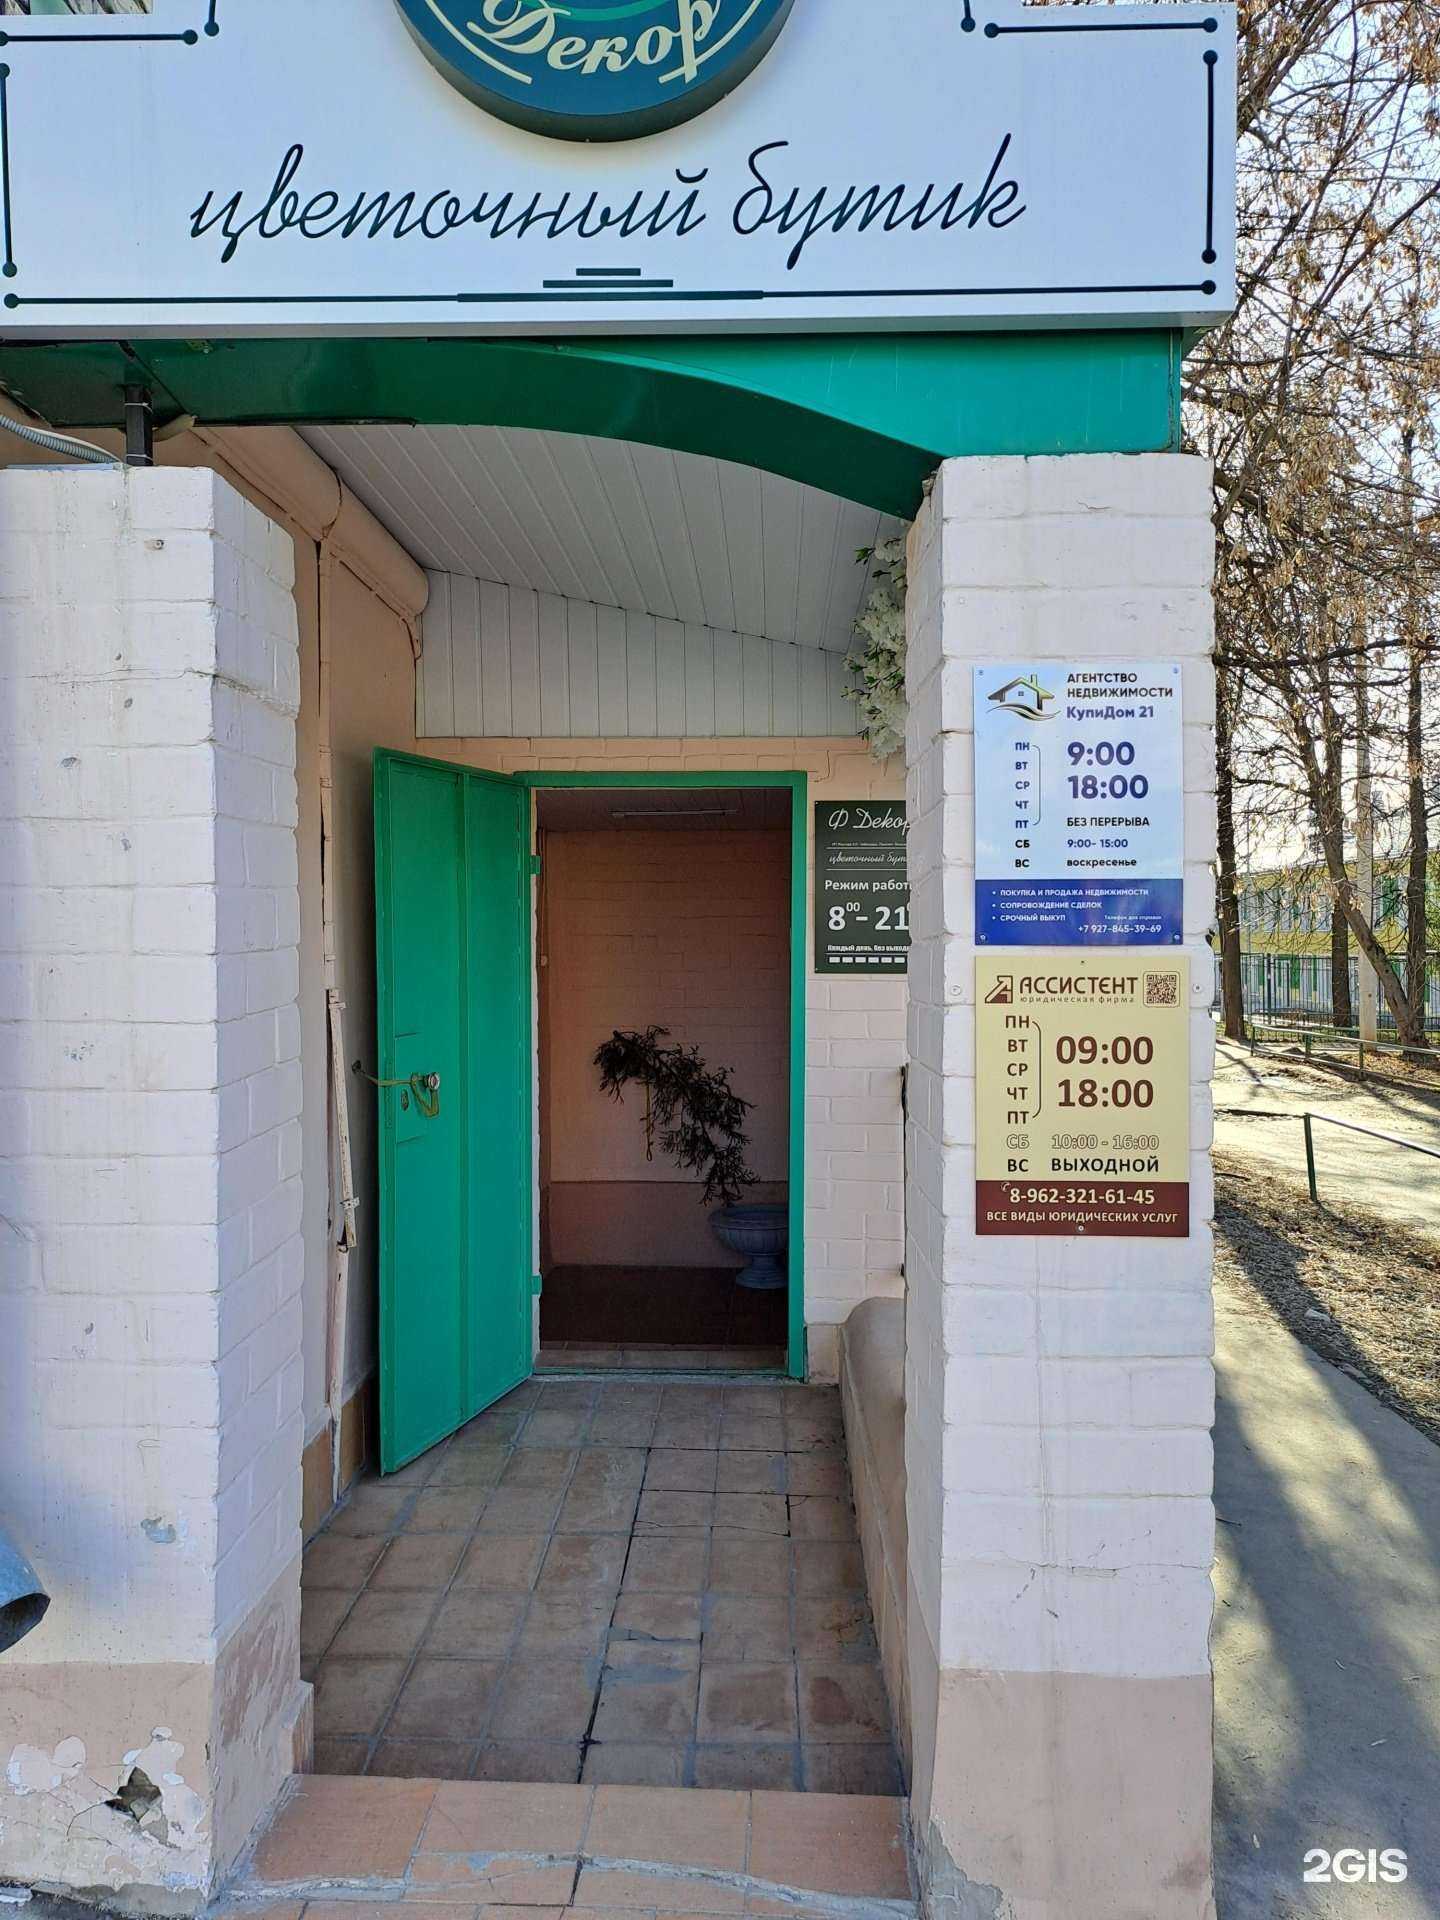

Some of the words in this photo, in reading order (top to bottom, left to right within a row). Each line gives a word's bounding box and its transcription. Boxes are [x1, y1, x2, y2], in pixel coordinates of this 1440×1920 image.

[466, 0, 722, 84] Декор
[189, 143, 709, 263] цветочный
[733, 133, 1026, 270] бутик
[1067, 673, 1138, 683] АГЕНТСТВО
[1067, 687, 1173, 699] НЕДВИЖИМОСТИ
[1066, 706, 1135, 721] КупиДом
[1139, 705, 1154, 718] 21
[1015, 742, 1030, 751] ПН
[1067, 741, 1136, 766] 9:00
[1015, 761, 1029, 770] ВТ
[1015, 781, 1030, 790] СР
[1067, 775, 1149, 799] 18:00
[1015, 800, 1029, 810] ЧТ
[828, 808, 849, 830] Ф
[1015, 820, 1029, 829] ПТ
[1067, 817, 1087, 827] БЕЗ
[1090, 817, 1149, 827] ПЕРЕРЫВА
[1015, 840, 1030, 849] СБ
[1100, 839, 1129, 848] 15:00
[1015, 859, 1030, 868] ВС
[1067, 858, 1137, 868] воскресенье
[825, 880, 869, 890] Режим
[1045, 889, 1083, 897] ПРОДАЖА
[1000, 913, 1038, 921] СРОЧНЫЙ
[1078, 924, 1089, 933] +7
[1091, 924, 1162, 933] 927-845-39-69
[1019, 976, 1138, 994] АССИСТЕНТ
[1020, 996, 1094, 1004] юридическая
[1098, 996, 1134, 1004] фирма
[1005, 1015, 1030, 1029] ПН
[1008, 1039, 1028, 1053] ВТ
[1056, 1035, 1154, 1065] 09:00
[1007, 1063, 1028, 1077] СР
[1007, 1087, 1028, 1100] ЧТ
[1057, 1078, 1154, 1108] 18:00
[1007, 1111, 1029, 1125] ПТ
[1006, 1134, 1030, 1149] СБ
[1052, 1134, 1098, 1150] 10:00
[1112, 1134, 1159, 1150] 16:00
[1007, 1158, 1029, 1172] ВС
[1051, 1156, 1159, 1175] ВЫХОДНОЙ
[1009, 1188, 1155, 1204] 8-962-321-61-45
[987, 1211, 1007, 1221] ВСЕ
[1010, 1211, 1046, 1222] ВИДЫ
[1049, 1212, 1139, 1223] ЮРИДИЧЕСКИХ
[1142, 1213, 1177, 1223] УСЛУГ
